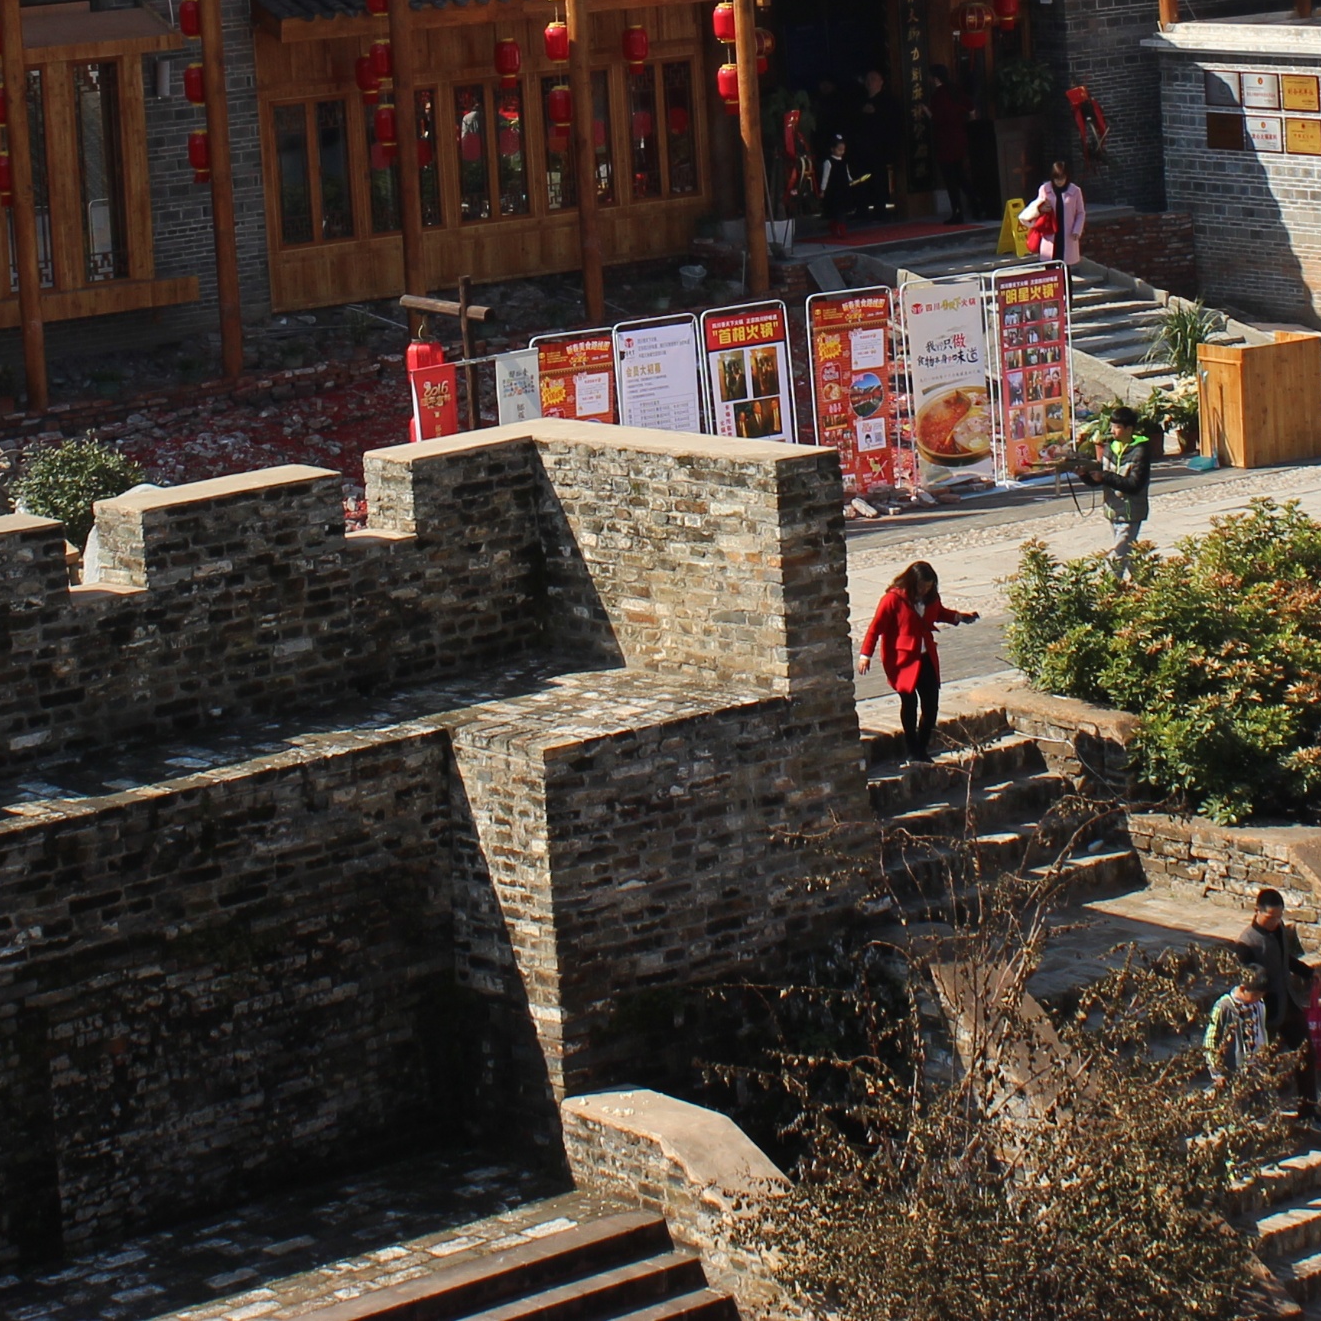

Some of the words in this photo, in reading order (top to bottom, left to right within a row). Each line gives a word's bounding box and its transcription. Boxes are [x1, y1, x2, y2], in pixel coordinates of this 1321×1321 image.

[926, 333, 966, 353] 我们只做
[423, 380, 449, 398] 2016
